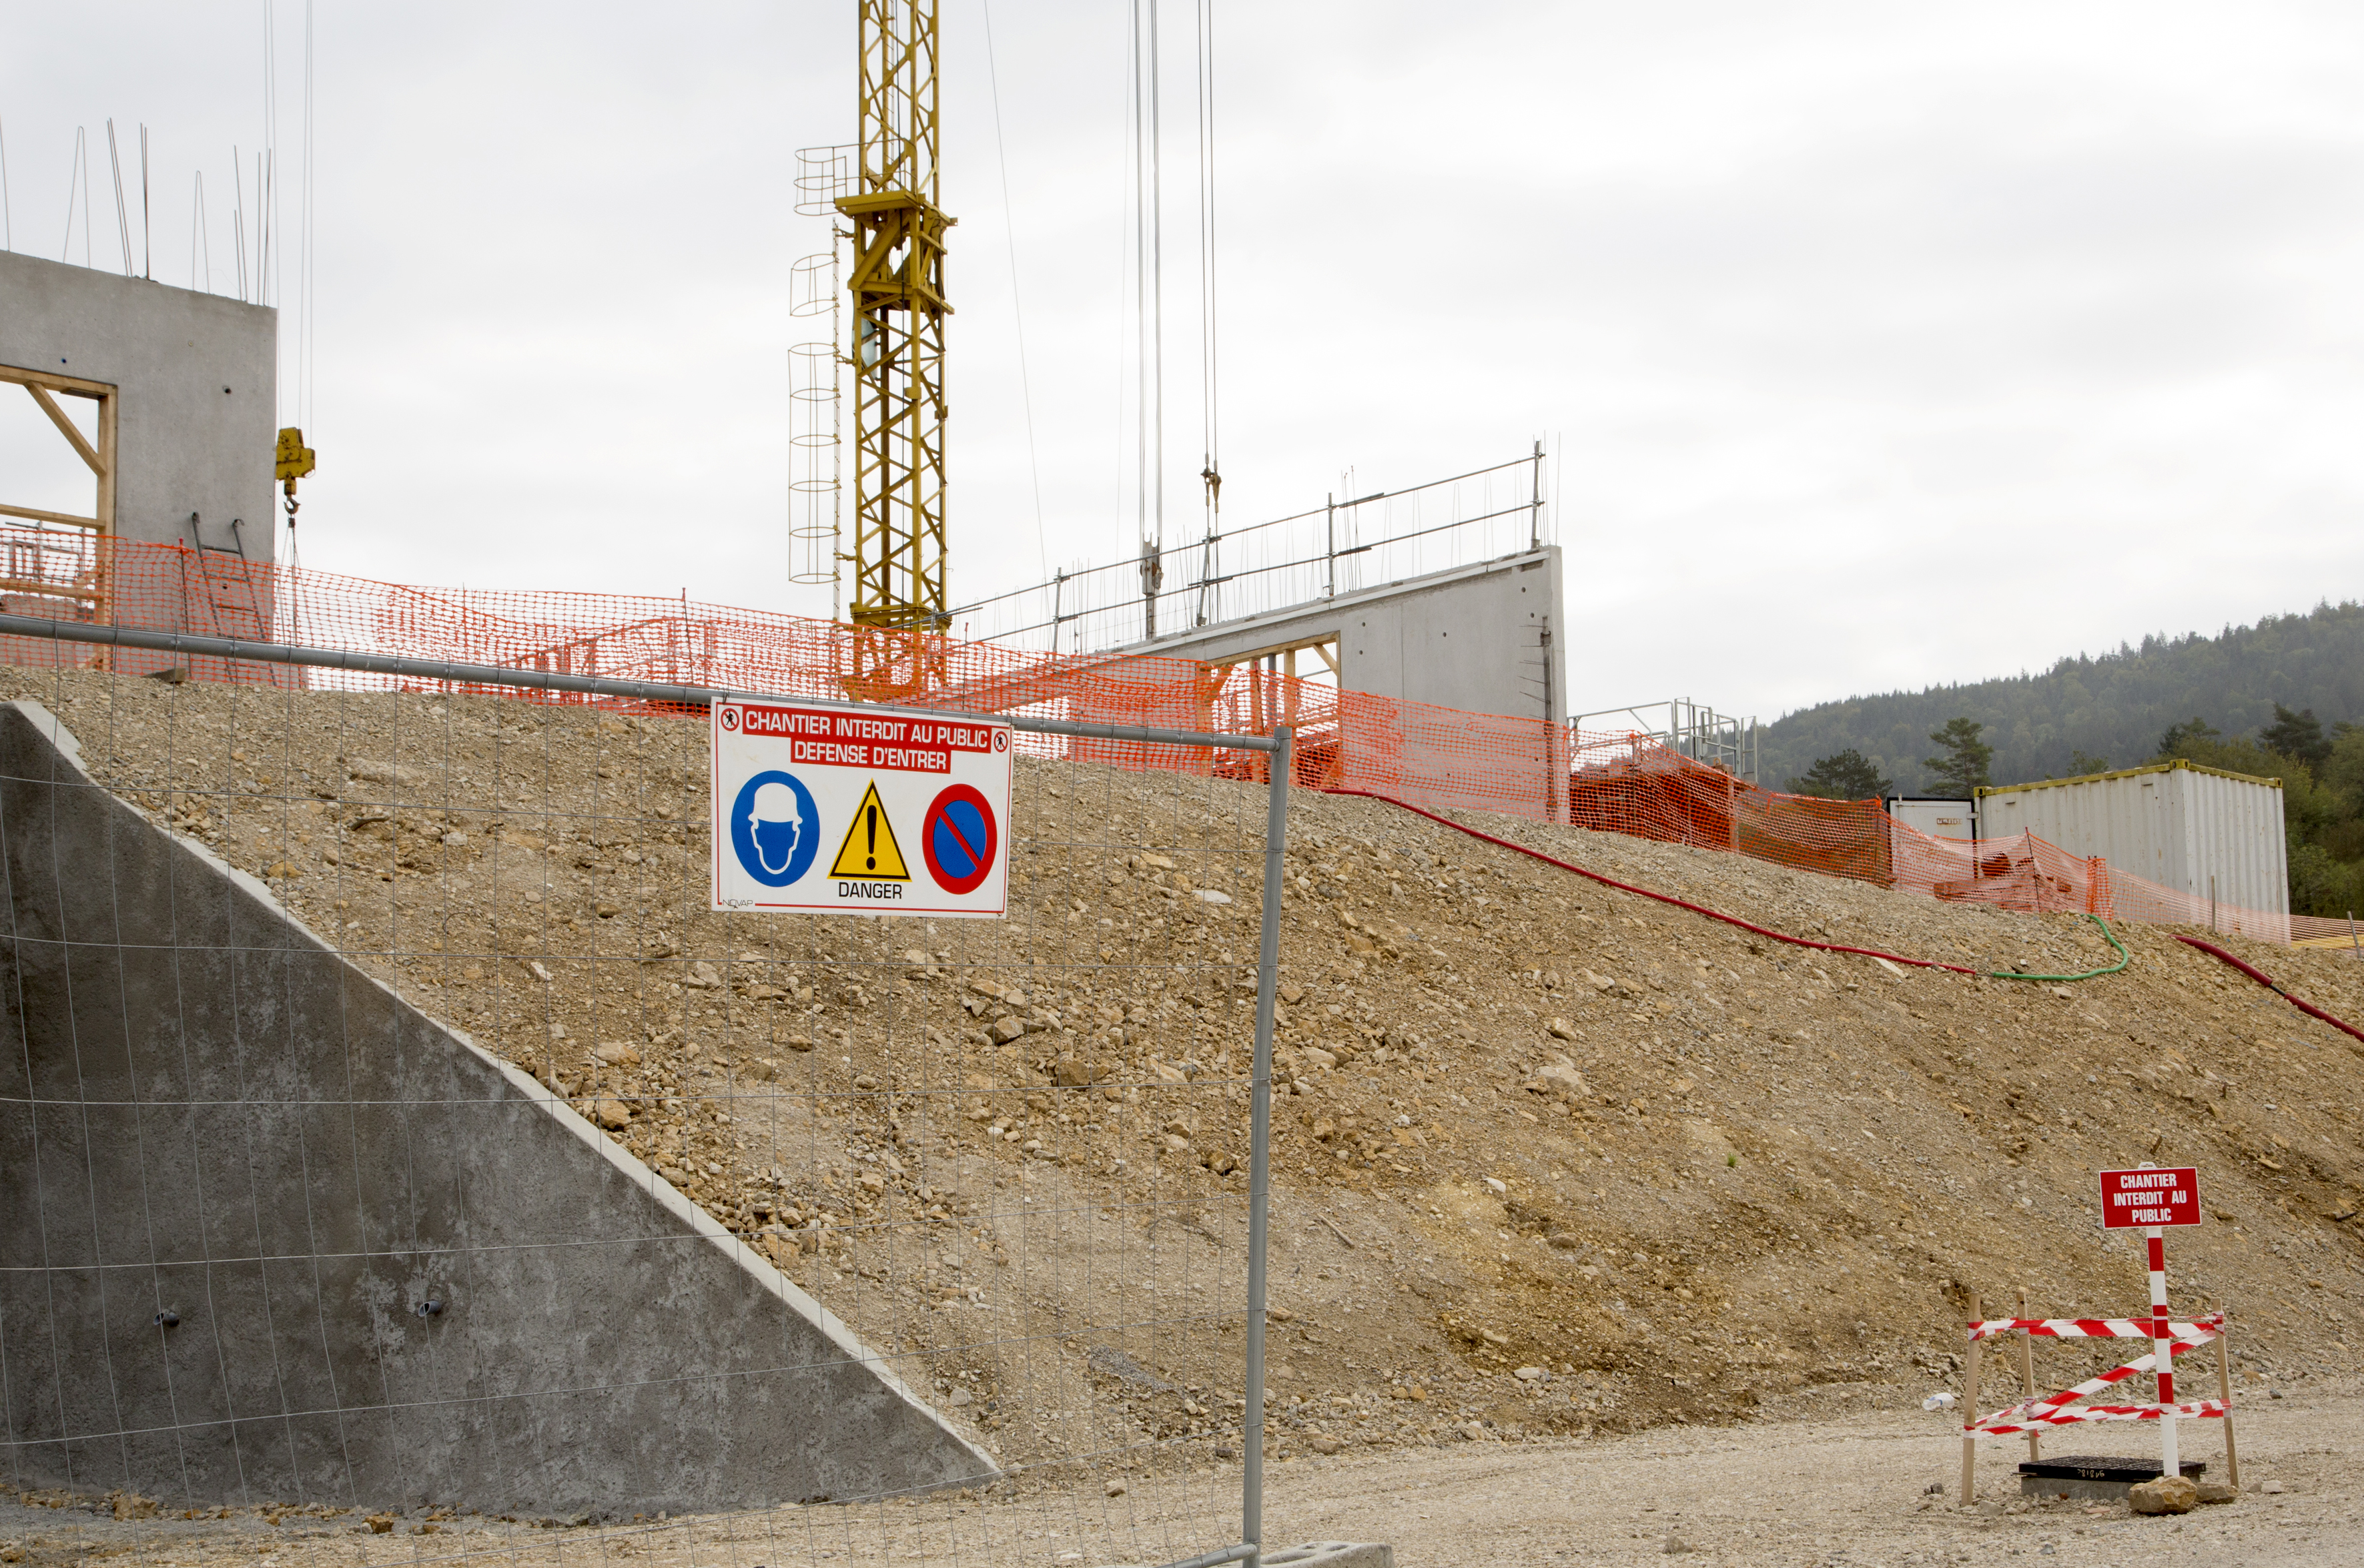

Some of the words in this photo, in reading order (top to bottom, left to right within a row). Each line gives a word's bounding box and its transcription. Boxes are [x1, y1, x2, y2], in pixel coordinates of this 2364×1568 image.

[745, 710, 831, 735] CHANTIER
[836, 717, 907, 741] INTERDIT
[910, 724, 932, 743] AU
[937, 726, 988, 748] PUBLIC
[795, 741, 868, 764] DEFENSE
[873, 747, 947, 770] D'ENTRER
[839, 881, 902, 899] DANGER
[723, 899, 753, 907] NOVAP
[2120, 1173, 2177, 1189] CHANTIER
[2113, 1191, 2164, 1206] INTERDIT
[2171, 1190, 2187, 1204] AU
[2131, 1208, 2172, 1223] PUBLIC
